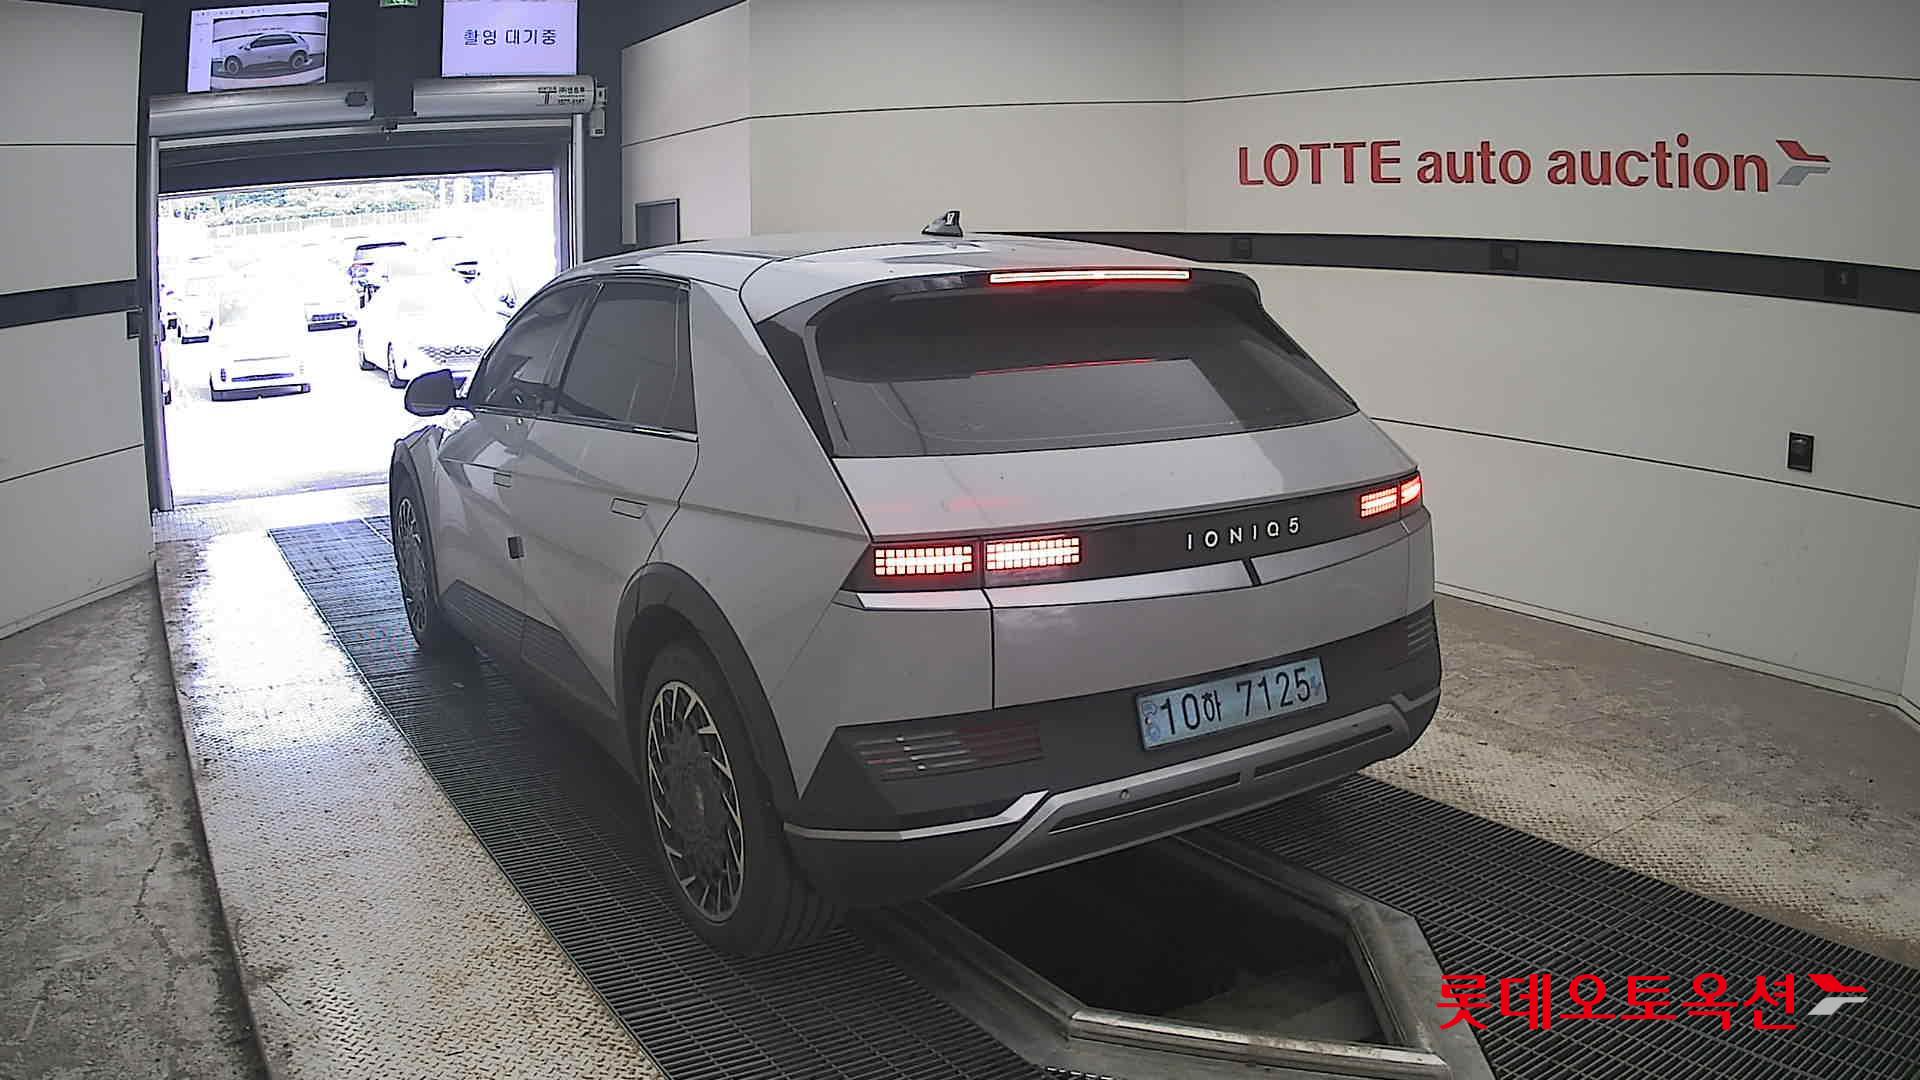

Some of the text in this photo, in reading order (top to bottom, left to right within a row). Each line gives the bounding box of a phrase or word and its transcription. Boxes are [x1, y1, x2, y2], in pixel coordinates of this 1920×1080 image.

[464, 29, 556, 46] 촬영 대기중
[1238, 132, 1769, 192] LOTTE auto auction
[1160, 667, 1311, 735] 10하 7125
